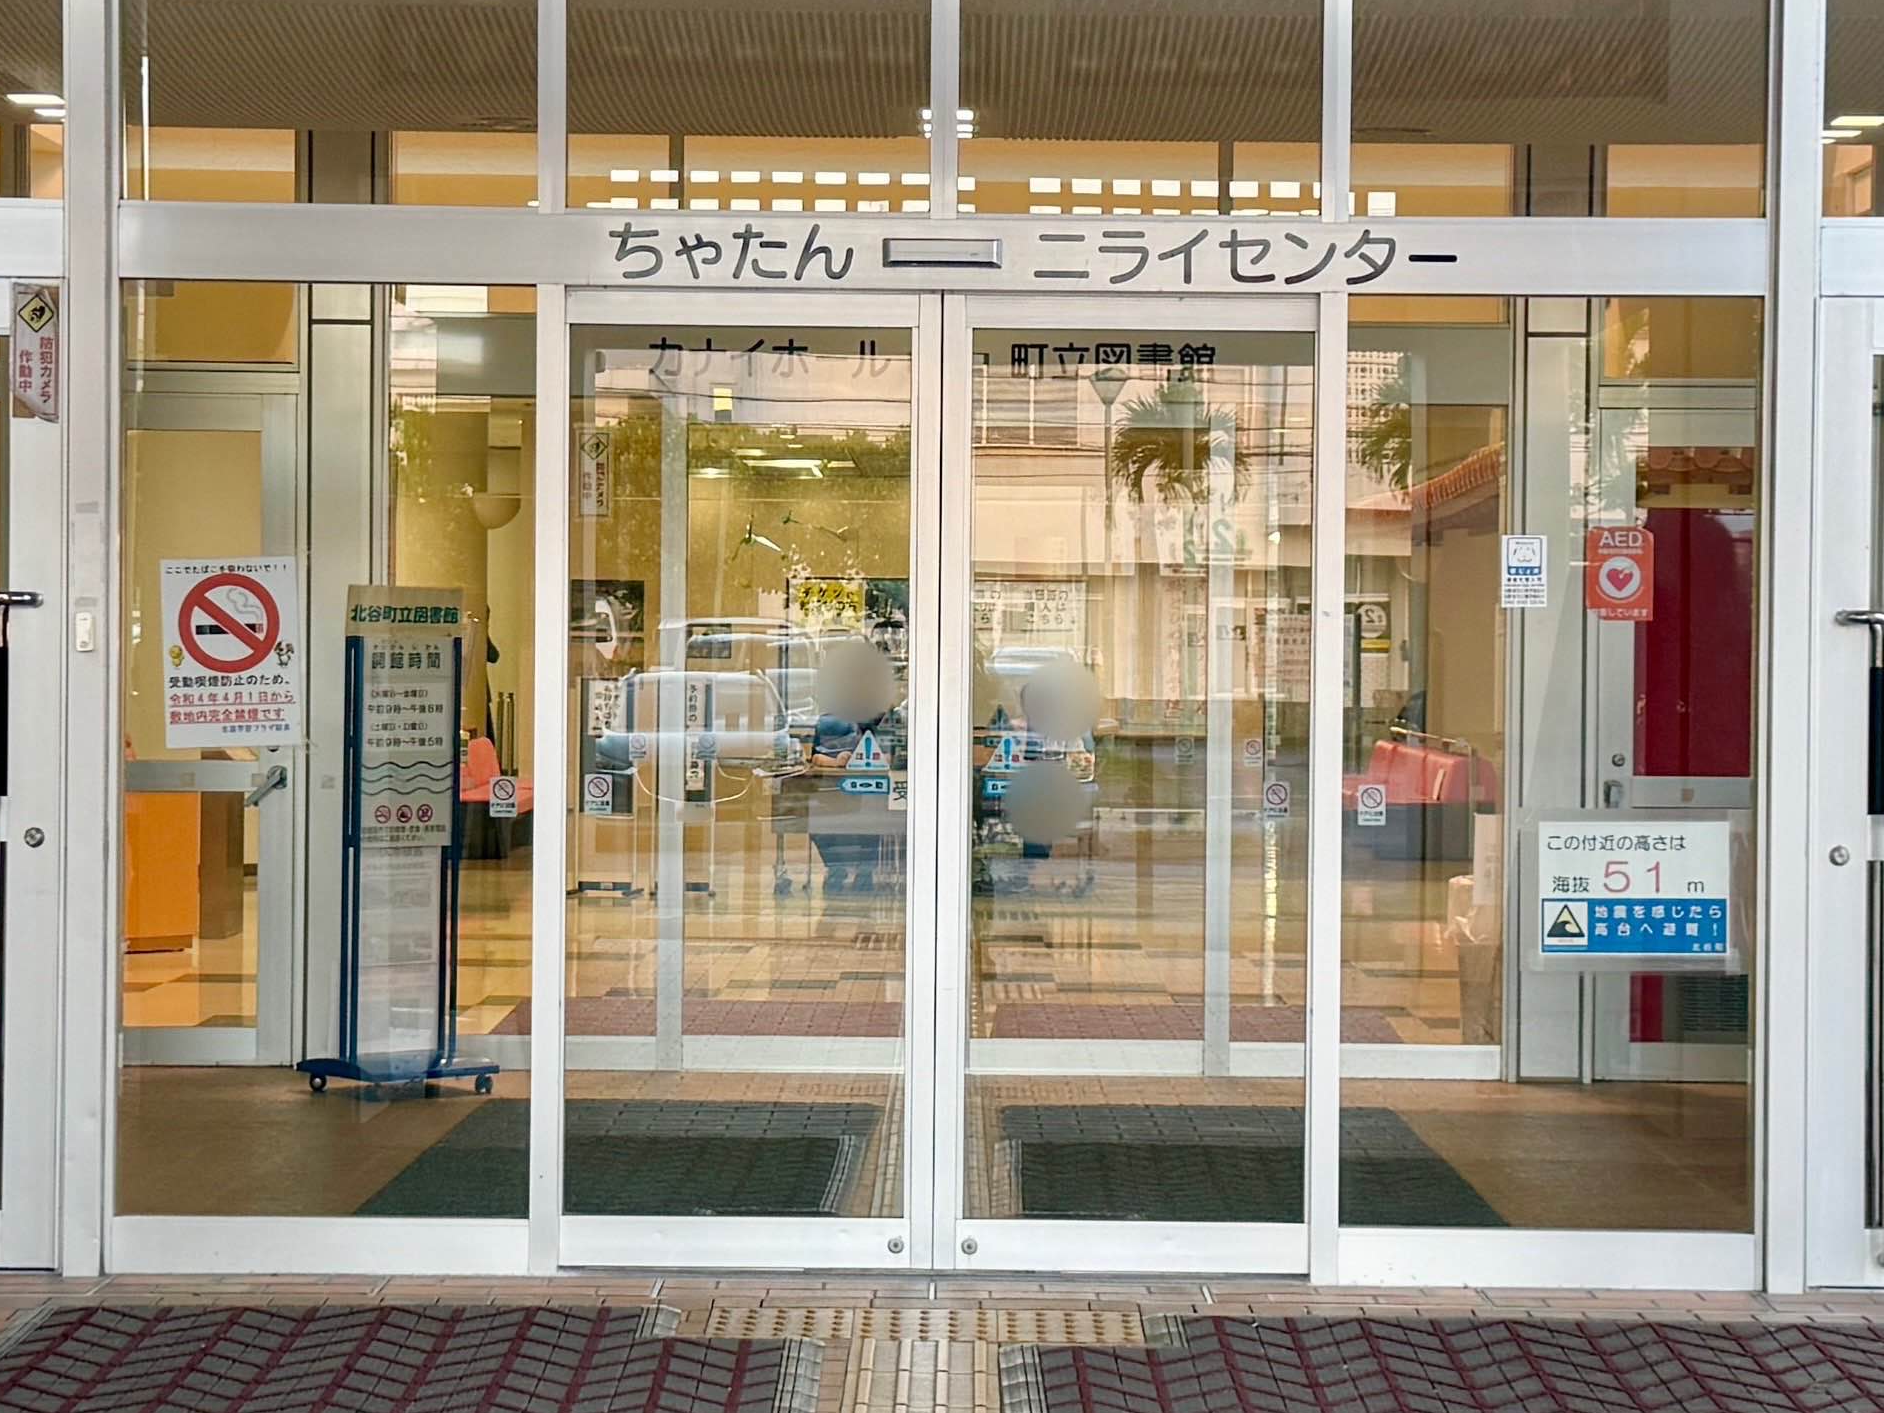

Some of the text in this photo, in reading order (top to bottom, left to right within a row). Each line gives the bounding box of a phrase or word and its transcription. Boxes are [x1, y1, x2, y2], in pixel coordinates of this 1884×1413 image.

[608, 221, 1457, 286] ちゃたん ニライセンター
[649, 337, 890, 378] カナイホル
[1011, 342, 1216, 381] 町立図書館
[1600, 532, 1642, 546] AED
[351, 604, 459, 624] 北谷町立図書館
[1547, 834, 1686, 851] この付近の高さは
[1552, 876, 1590, 893] 海抜
[1687, 880, 1704, 893] m
